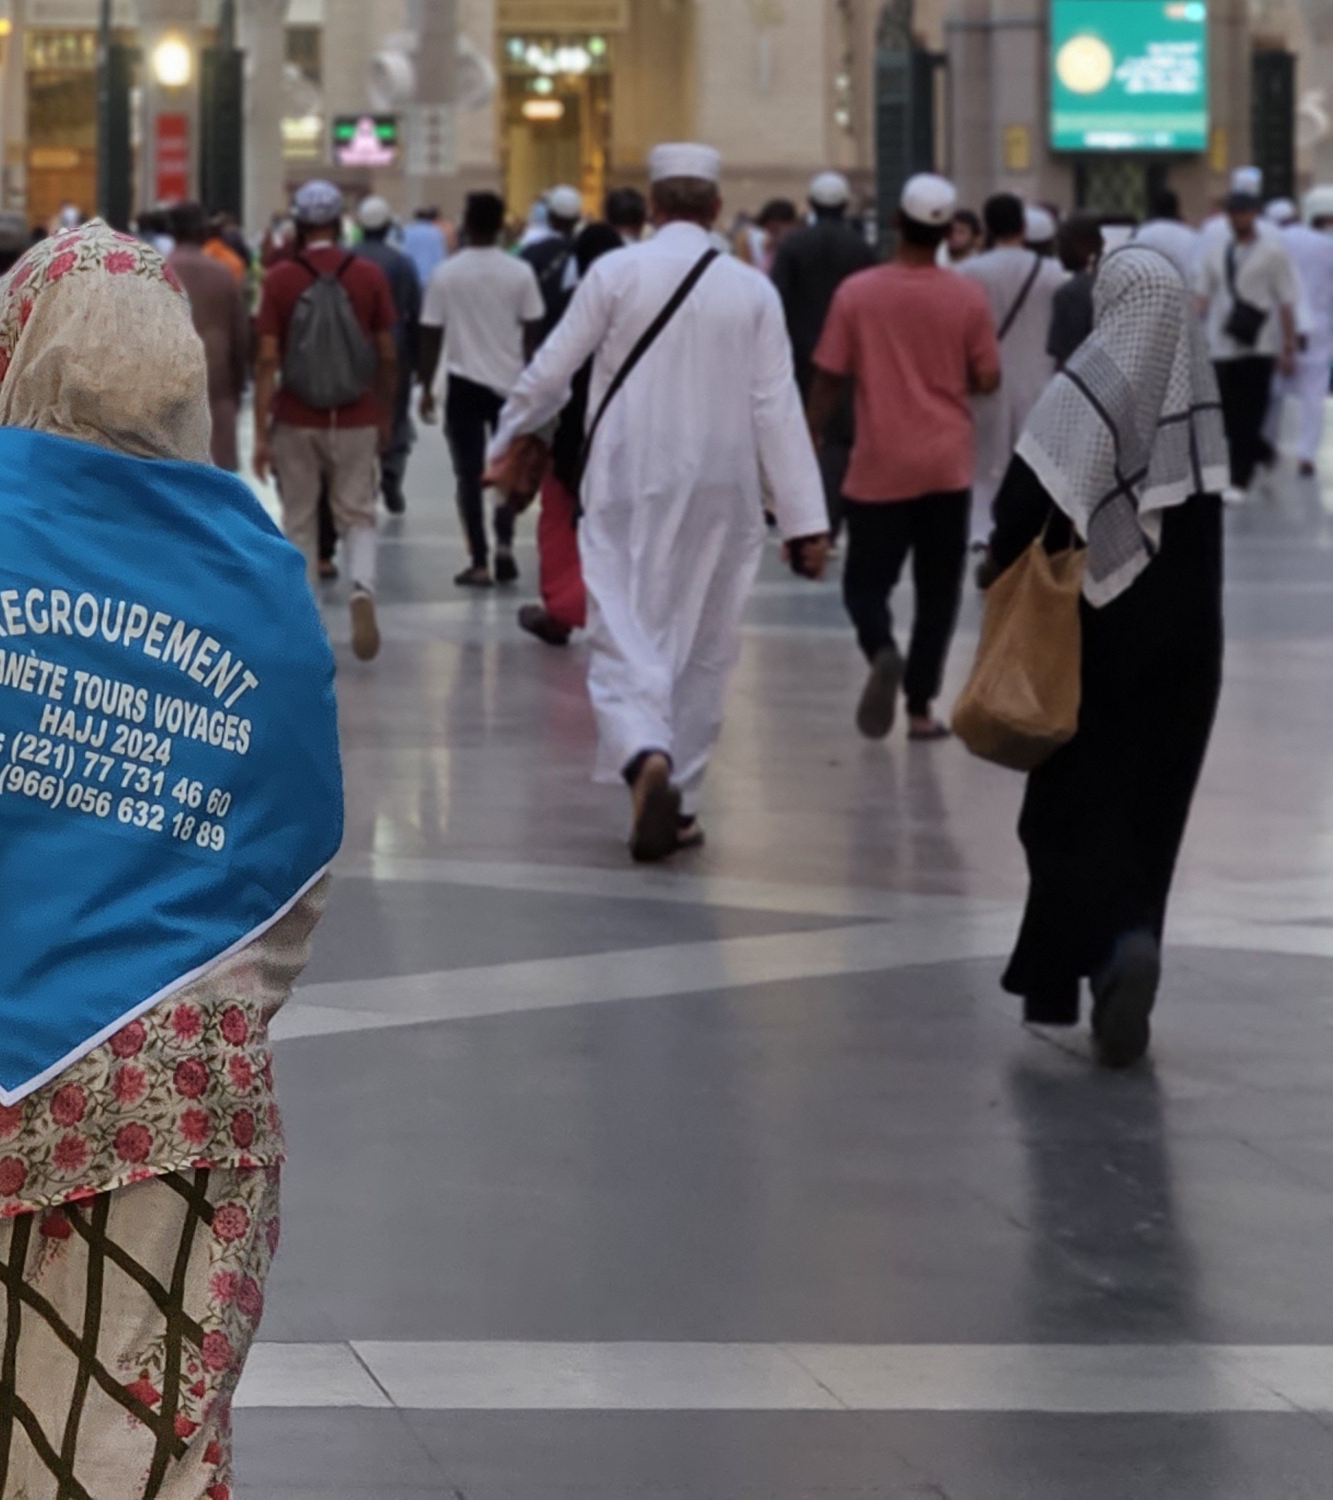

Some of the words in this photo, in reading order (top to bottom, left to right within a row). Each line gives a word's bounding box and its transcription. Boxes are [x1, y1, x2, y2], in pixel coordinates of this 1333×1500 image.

[38, 703, 109, 748] HAJJ
[109, 724, 172, 767] 2024
[73, 670, 149, 724] TOURS
[154, 693, 252, 755] VOYAGES
[10, 731, 75, 779] (221)
[82, 750, 116, 783] 77
[120, 761, 165, 797] 731
[171, 776, 204, 809] 46
[205, 787, 232, 818] 60
[117, 796, 166, 832] 632
[171, 811, 196, 841] 18
[196, 820, 226, 852] 89
